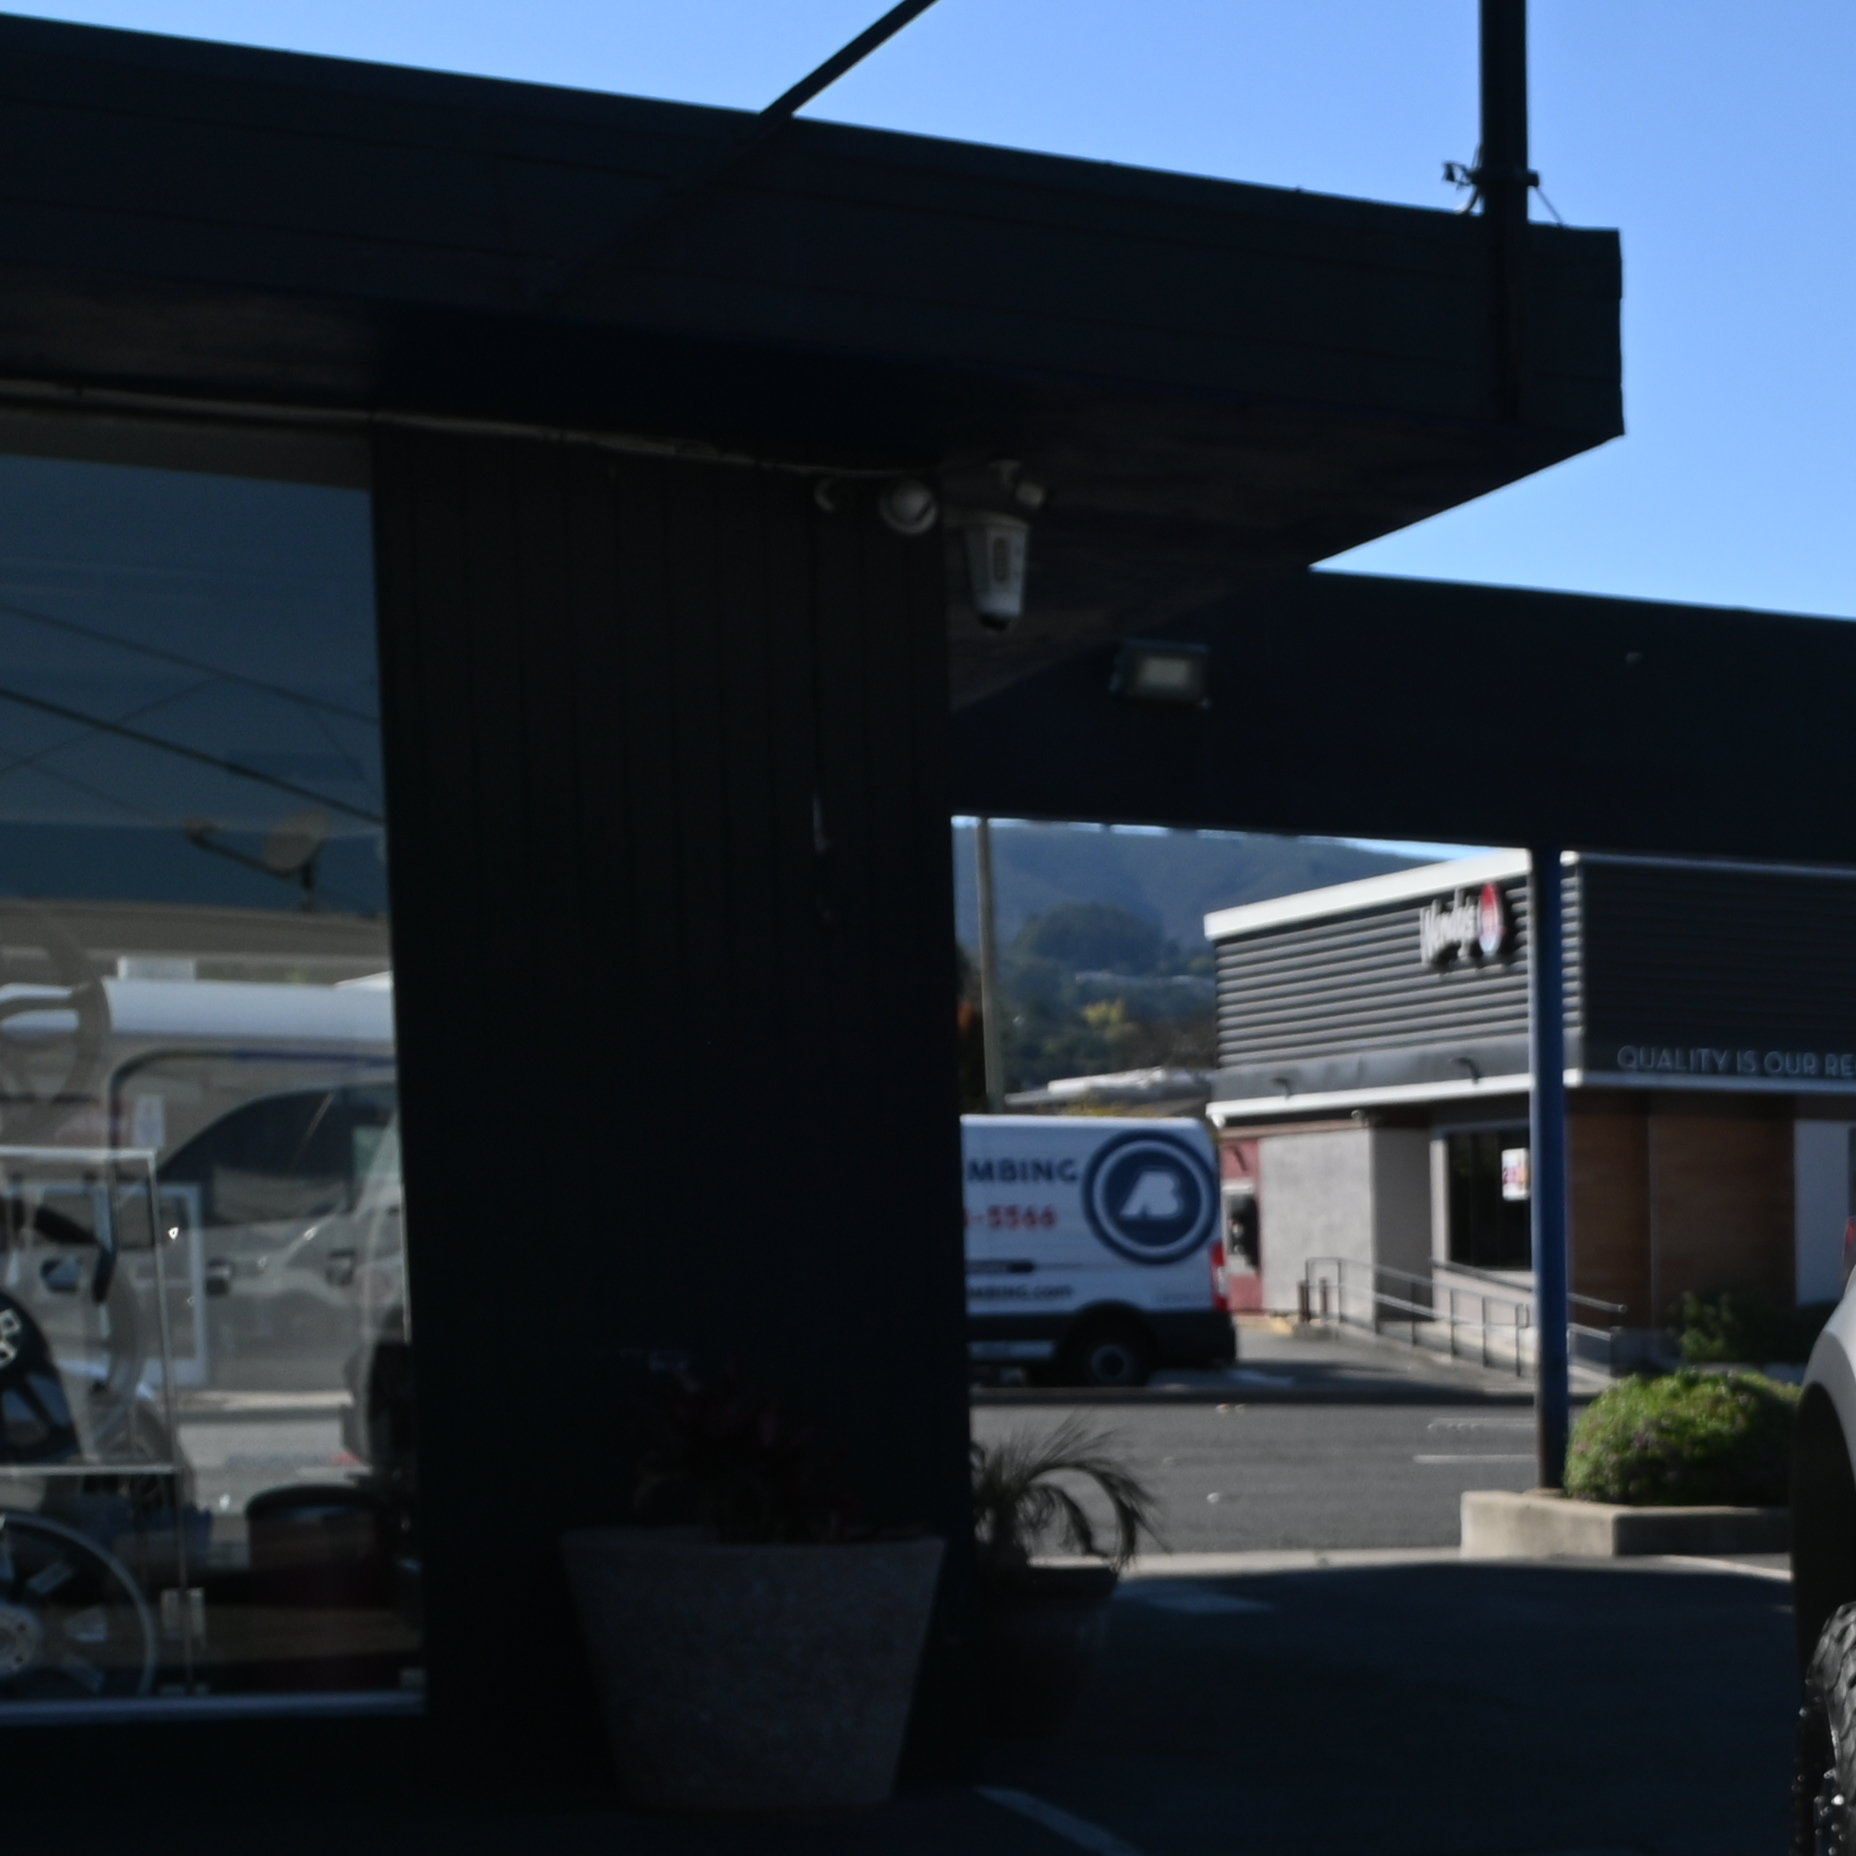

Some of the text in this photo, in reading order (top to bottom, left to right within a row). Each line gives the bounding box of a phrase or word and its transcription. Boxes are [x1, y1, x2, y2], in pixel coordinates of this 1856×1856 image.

[1616, 1045, 1729, 1073] QUALITY
[1736, 1049, 1757, 1073] IS
[1764, 1051, 1816, 1075] OUR
[963, 1204, 1057, 1230] -5566
